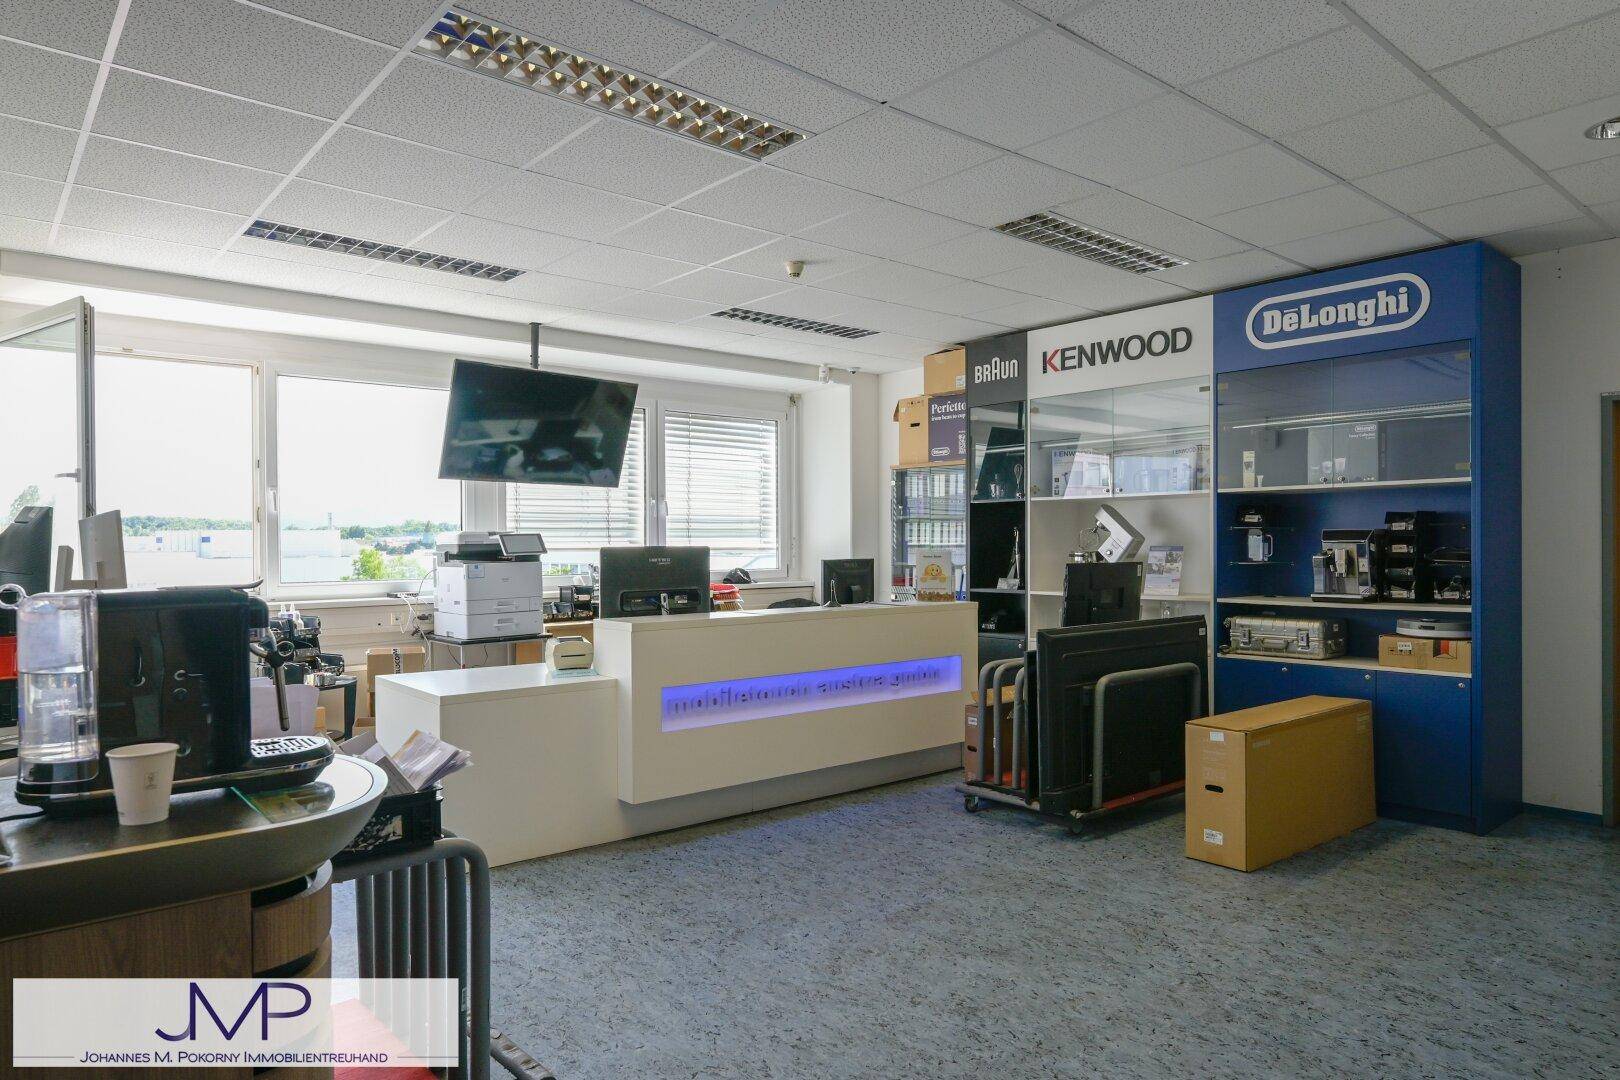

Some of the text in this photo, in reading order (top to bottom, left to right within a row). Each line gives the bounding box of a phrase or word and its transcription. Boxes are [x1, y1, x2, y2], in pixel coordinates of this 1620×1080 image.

[1042, 326, 1193, 374] KENWOOD
[974, 356, 1019, 384] BRAUN
[931, 401, 966, 414] Perfetto
[817, 674, 885, 695] austria
[889, 665, 941, 690] gmbh
